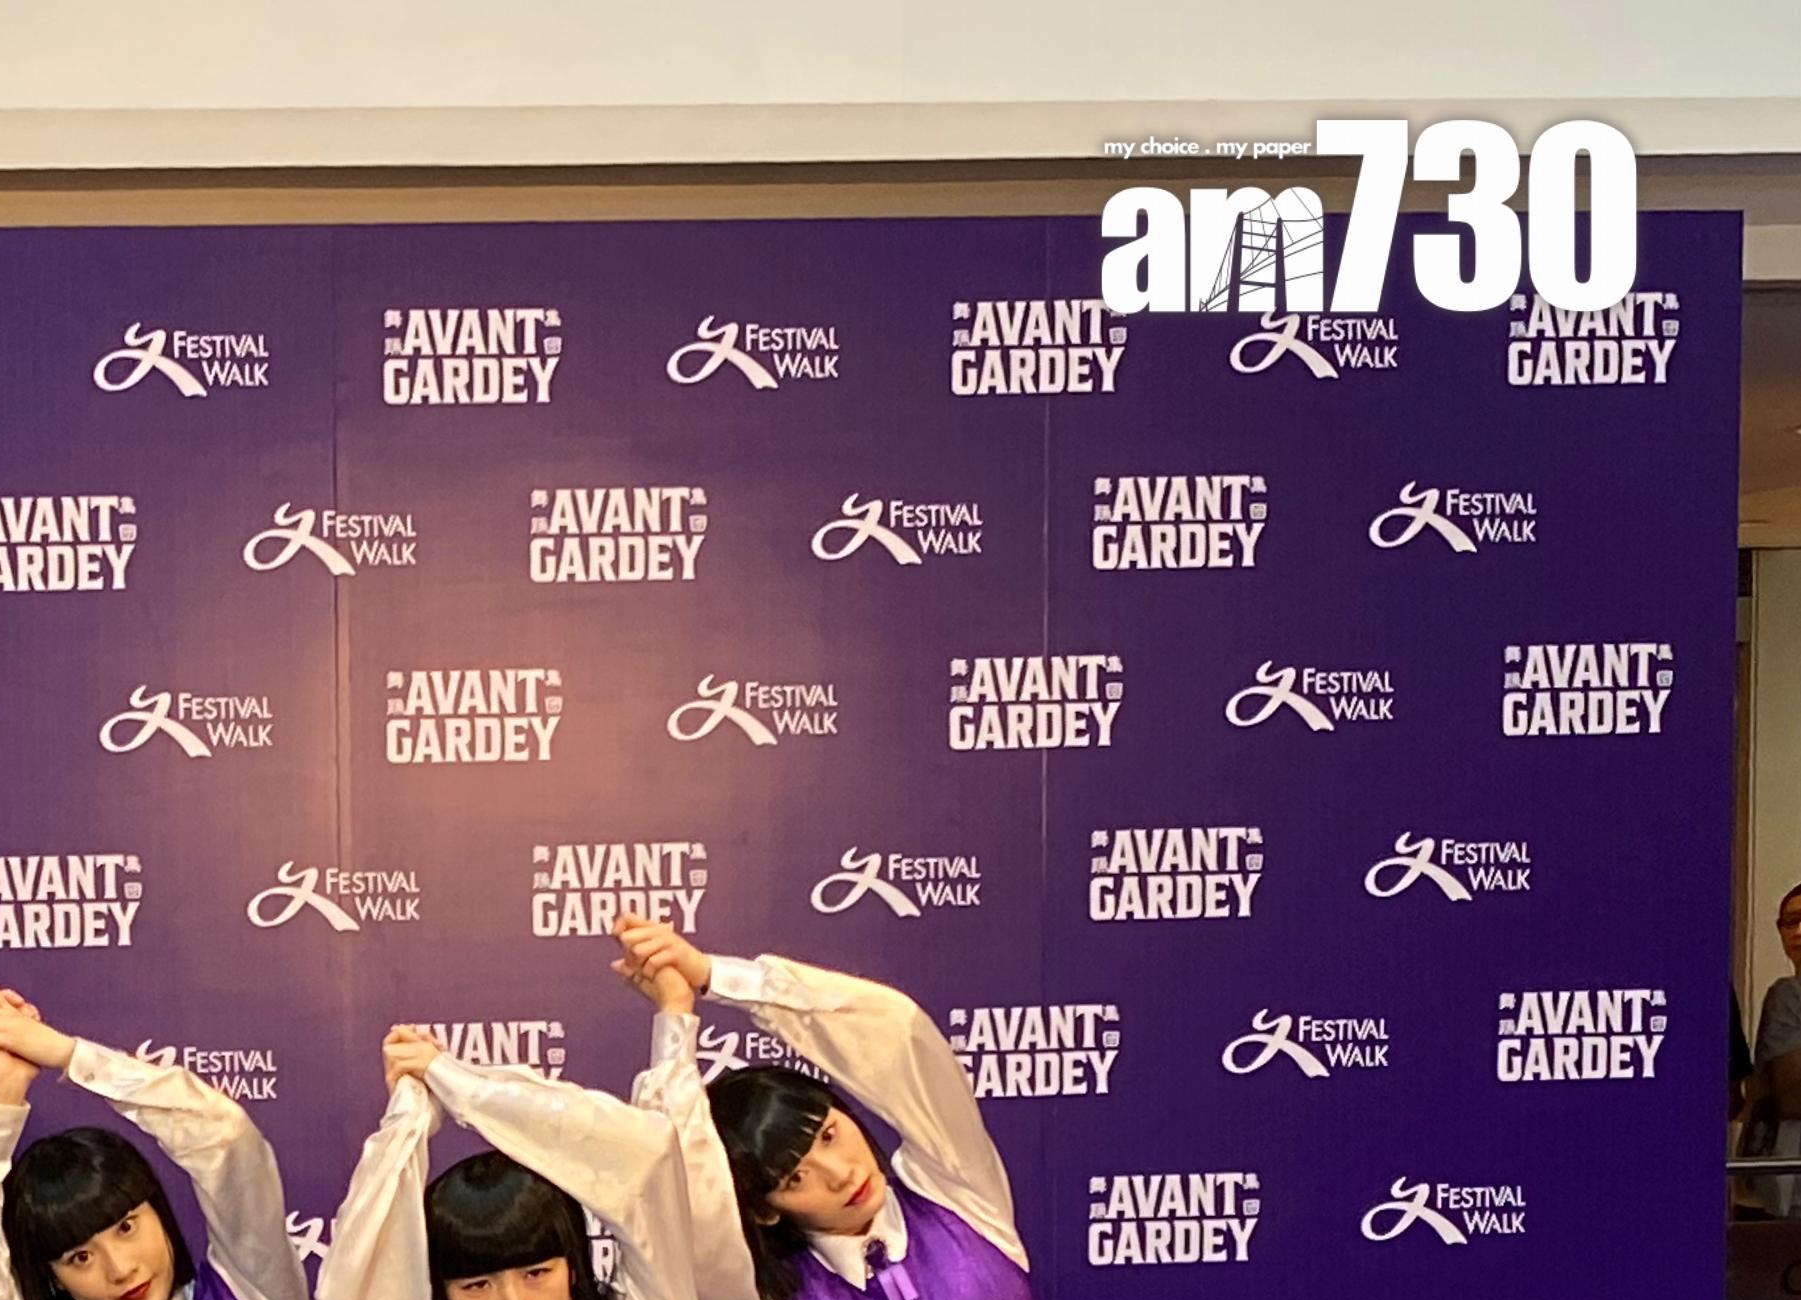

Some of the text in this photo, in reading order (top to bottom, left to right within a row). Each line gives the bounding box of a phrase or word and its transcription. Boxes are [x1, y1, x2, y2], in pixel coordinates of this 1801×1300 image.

[402, 308, 545, 355] AVANT
[971, 299, 1110, 346] AVANT
[1308, 314, 1397, 342] FESTIVAL
[173, 331, 268, 359] FESTIVAL
[746, 324, 838, 352] FESTIVAL
[772, 353, 838, 379] WALK
[1333, 343, 1397, 369] WALK
[1508, 339, 1676, 386] GARDEY
[201, 360, 268, 387] WALK
[383, 356, 559, 404] GARDEY
[952, 347, 1124, 394] GARDEY
[549, 487, 690, 534] AVANT
[1113, 474, 1250, 521] AVANT
[1447, 489, 1536, 516] FESTIVAL
[323, 510, 416, 538] FESTIVAL
[890, 500, 981, 528] FESTIVAL
[916, 529, 981, 555] WALK
[1472, 517, 1536, 543] WALK
[350, 539, 417, 566] WALK
[530, 535, 704, 583] GARDEY
[1094, 522, 1263, 569] GARDEY
[969, 655, 1107, 702] AVANT
[1522, 643, 1657, 689] AVANT
[405, 668, 546, 715] AVANT
[746, 681, 837, 708] FESTIVAL
[1303, 668, 1392, 695] FESTIVAL
[179, 692, 273, 720] FESTIVAL
[1328, 696, 1392, 722] WALK
[1503, 689, 1669, 737] GARDEY
[206, 721, 273, 748] WALK
[772, 710, 837, 735] WALK
[950, 702, 1120, 750] GARDEY
[385, 715, 560, 764] GARDEY
[1109, 826, 1246, 873] AVANT
[1442, 838, 1530, 865] FESTIVAL
[551, 841, 691, 889] AVANT
[889, 854, 980, 881] FESTIVAL
[1467, 866, 1530, 892] WALK
[326, 868, 419, 895] FESTIVAL
[915, 882, 980, 908] WALK
[353, 896, 419, 922] WALK
[1091, 873, 1259, 921] GARDEY
[1516, 988, 1651, 1035] AVANT
[968, 1004, 1105, 1051] AVANT
[1300, 1016, 1388, 1043] FESTIVAL
[183, 1046, 278, 1073] FESTIVAL
[1325, 1043, 1388, 1069] WALK
[1498, 1034, 1663, 1082] GARDEY
[1108, 1172, 1244, 1220] AVANT
[1437, 1183, 1525, 1210] FESTIVAL
[1462, 1210, 1525, 1235] WALK
[1089, 1218, 1257, 1267] GARDEY
